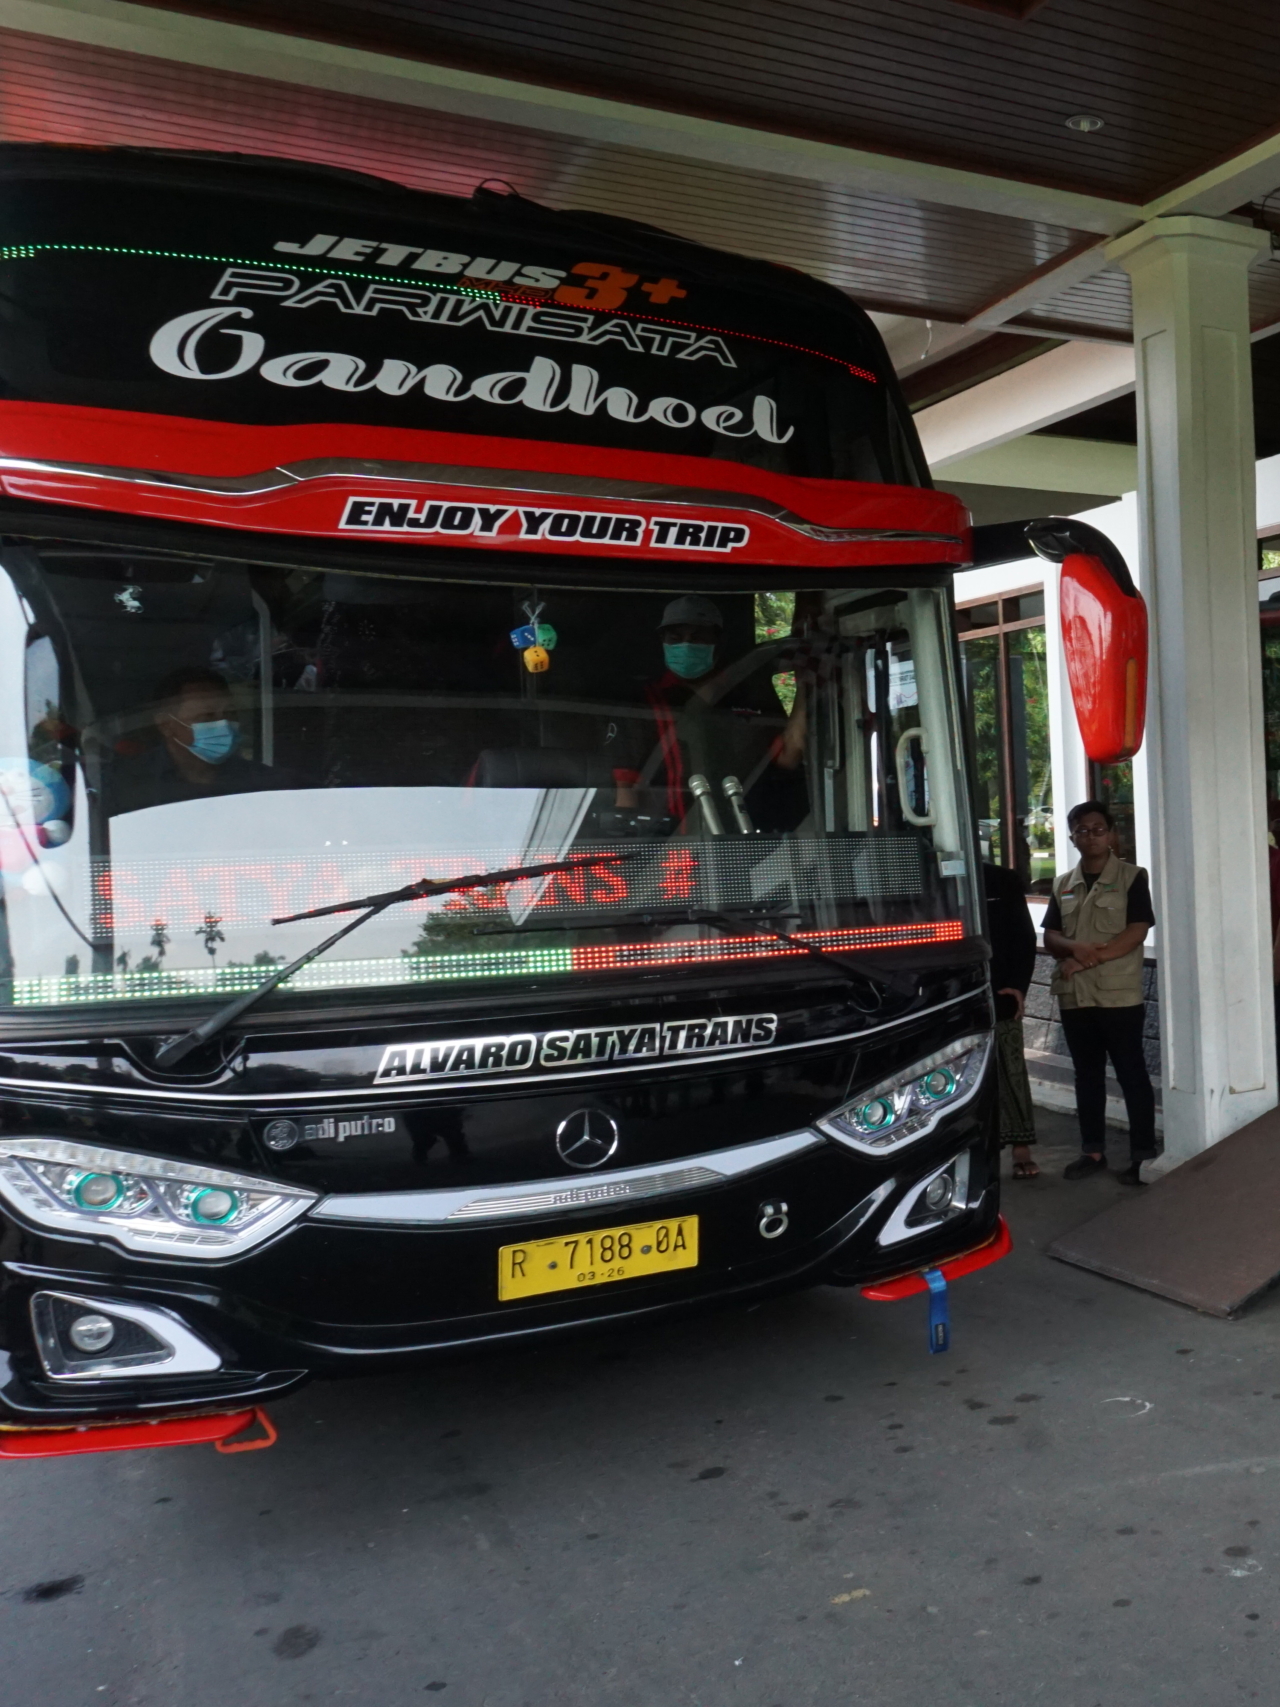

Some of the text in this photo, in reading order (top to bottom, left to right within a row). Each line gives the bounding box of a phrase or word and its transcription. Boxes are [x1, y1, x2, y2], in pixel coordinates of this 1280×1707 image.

[273, 234, 688, 310] JETBUS 3+
[208, 267, 738, 369] PARIWISATA
[149, 306, 794, 444] Gandhoel
[342, 498, 747, 550] ENJOY YOUR TRIP
[98, 863, 358, 928] SATYA
[391, 852, 629, 911] TRANS
[380, 1016, 777, 1079] ALVARO SATYA TRANS
[511, 1248, 527, 1279] R
[564, 1231, 633, 1270] 7188
